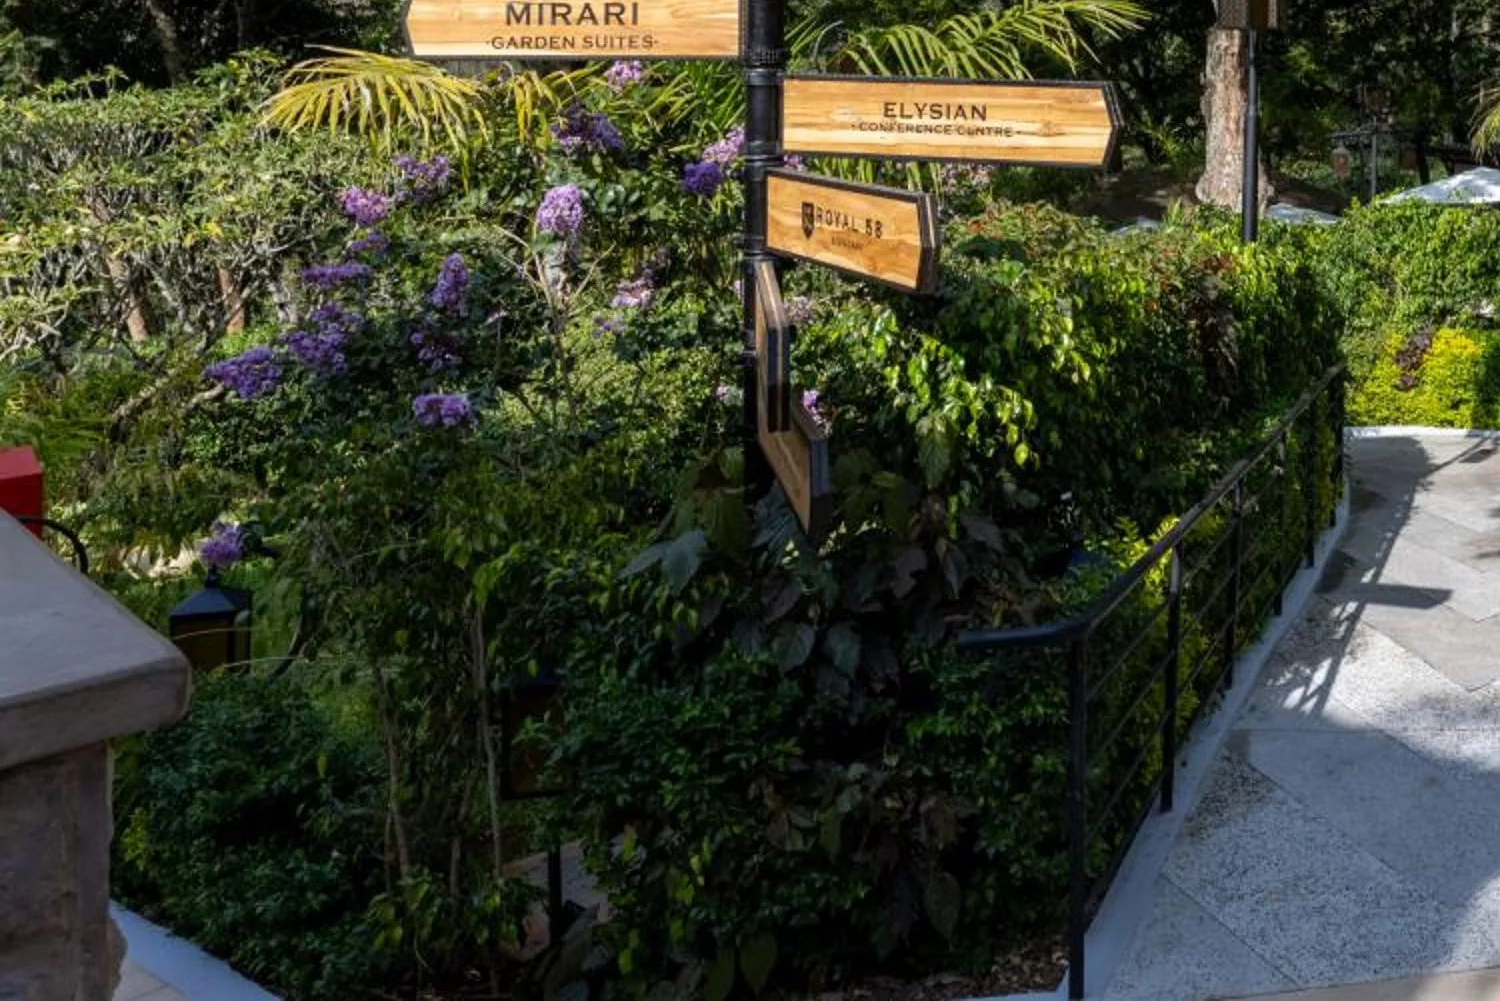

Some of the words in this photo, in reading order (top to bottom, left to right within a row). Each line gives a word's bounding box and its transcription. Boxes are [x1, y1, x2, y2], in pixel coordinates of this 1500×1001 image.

[506, 2, 639, 26] MIRARI
[491, 35, 575, 49] GARDEN
[582, 34, 653, 49] SUITES
[883, 102, 988, 121] ELYSIAN
[859, 121, 952, 136] CONFERENCE
[956, 124, 1013, 137] CENTRE
[815, 206, 859, 232] ROYAL
[865, 218, 883, 239] 58
